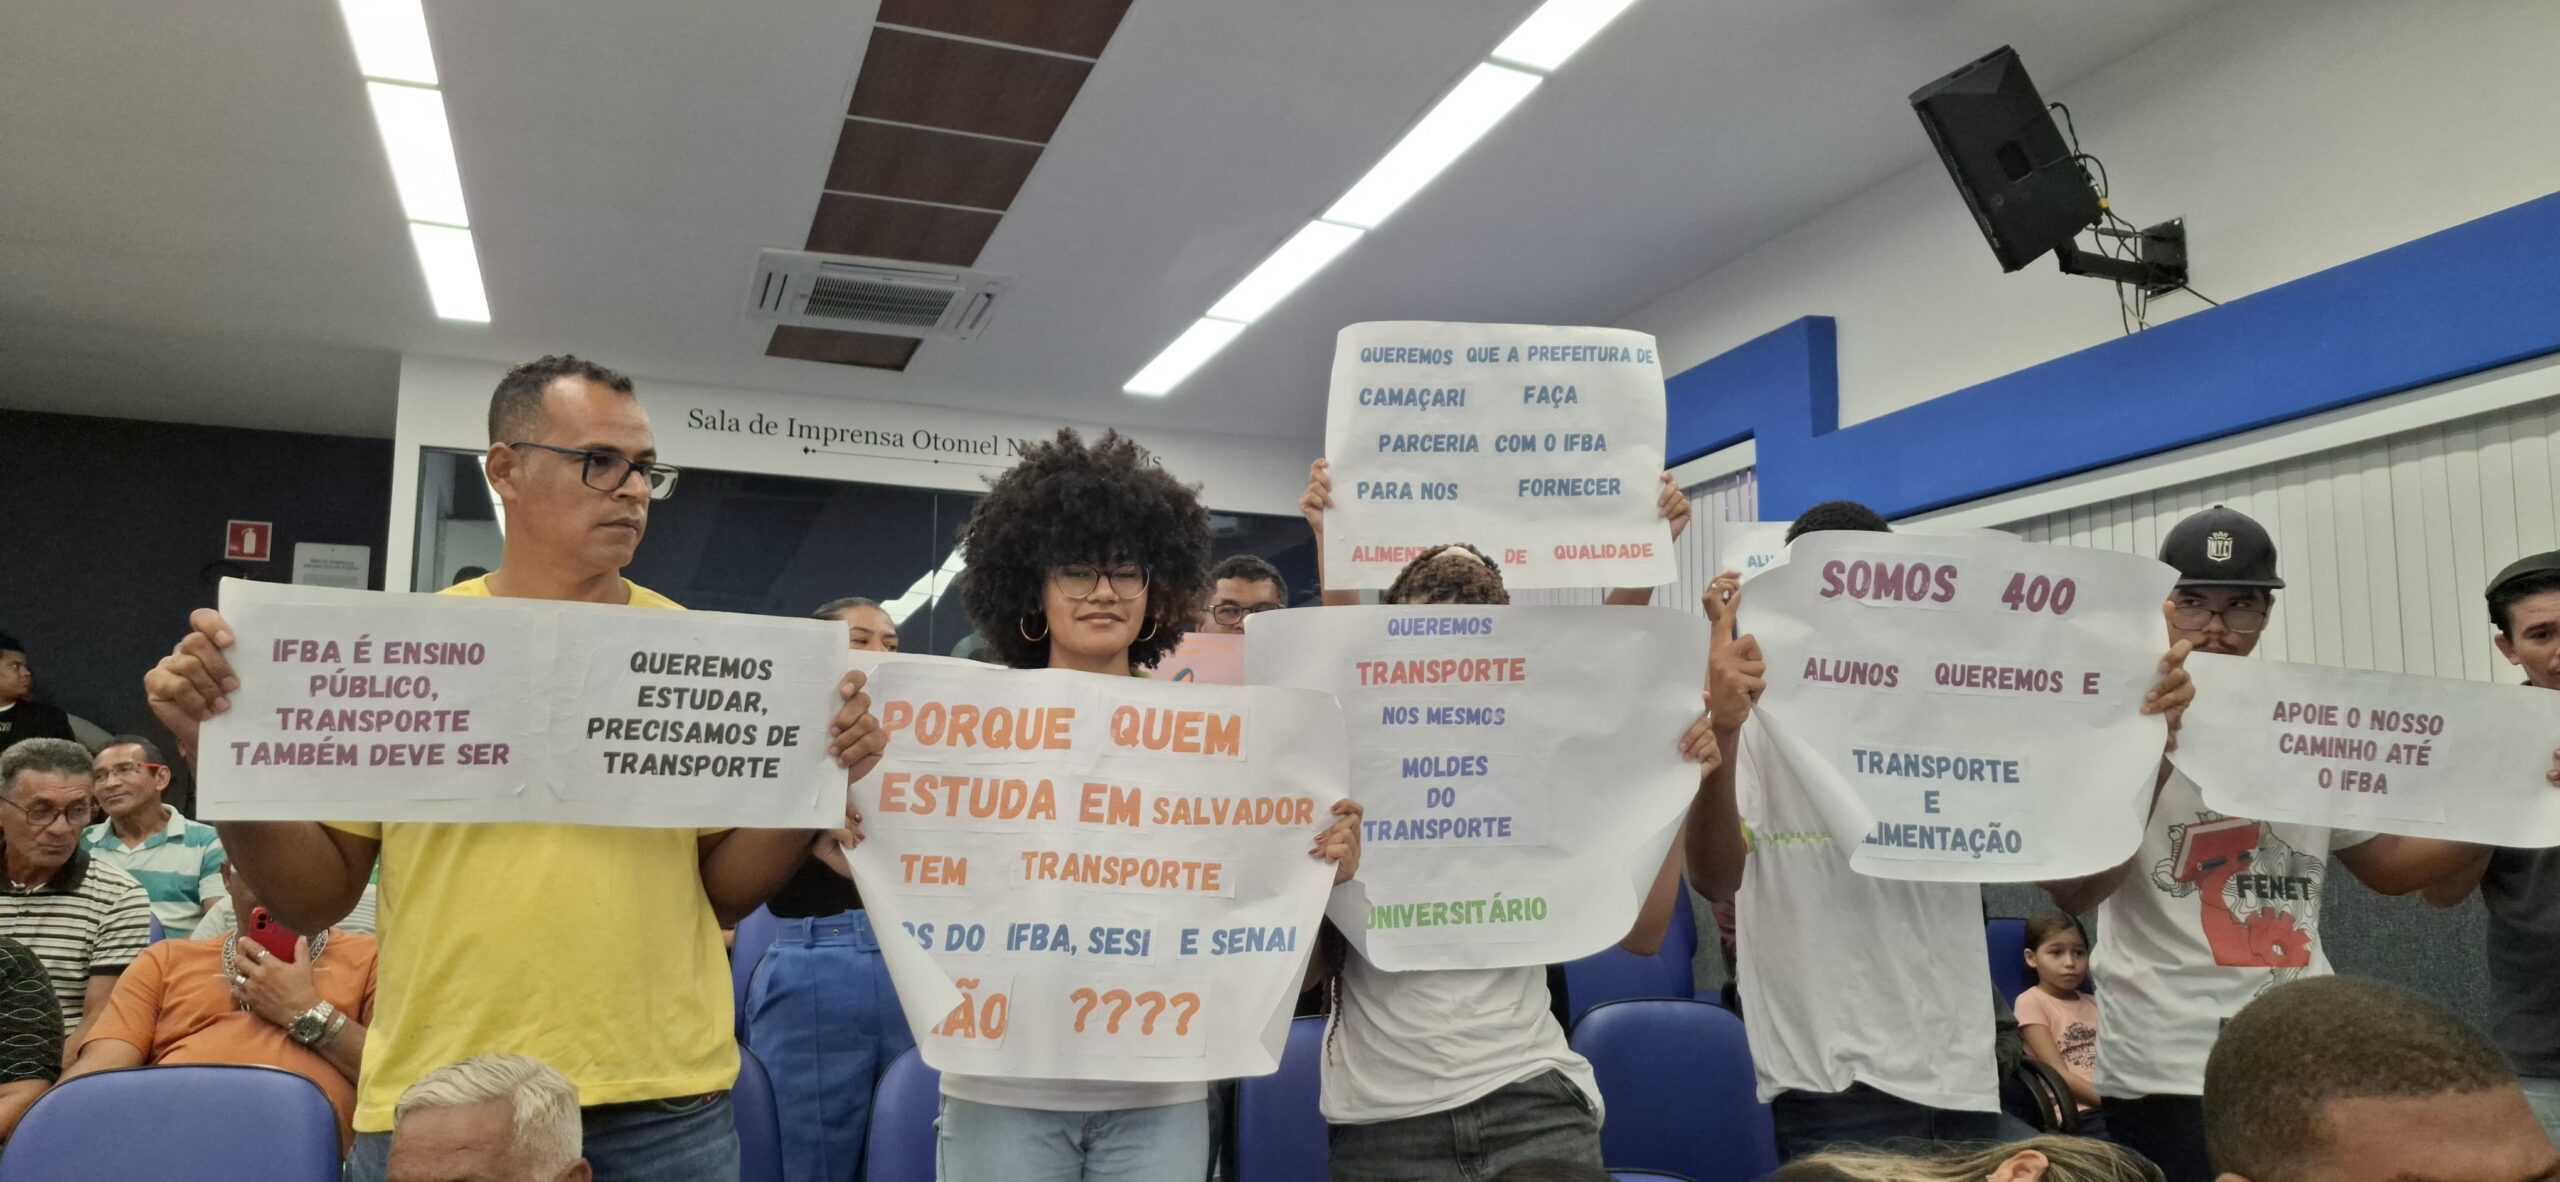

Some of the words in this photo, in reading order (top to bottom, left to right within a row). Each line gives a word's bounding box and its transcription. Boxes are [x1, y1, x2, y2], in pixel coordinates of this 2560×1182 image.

[1360, 347, 1454, 365] QUEREMOS
[1466, 347, 1500, 364] QUE
[1507, 347, 1520, 363] A
[1528, 346, 1631, 362] PREFEITURA
[1636, 348, 1655, 364] DE
[1359, 387, 1465, 411] CAMAÇARI
[1523, 385, 1578, 408] FAÇA
[688, 408, 741, 433] Sala
[749, 413, 778, 436] de
[788, 418, 904, 449] Imprensa
[1378, 434, 1479, 453] PARCERIA
[1495, 434, 1536, 453] COM
[1544, 434, 1556, 452] O
[1564, 433, 1607, 452] IFBA
[1357, 481, 1413, 500] PARA
[1420, 482, 1458, 500] NOS
[1518, 478, 1621, 497] FORNECER
[1505, 549, 1527, 564] DE
[1554, 544, 1654, 560] QUALIDADE
[1820, 560, 1958, 601] SOMOS
[2001, 573, 2076, 615] 400
[1388, 617, 1492, 636] QUEREMOS
[272, 640, 340, 664] IFBA
[353, 634, 372, 664] É
[384, 640, 485, 665] ENSINO
[630, 651, 773, 681] QUEREMOS
[1356, 658, 1526, 685] TRANSPORTE
[1803, 657, 1898, 688] ALUNOS
[1935, 663, 2063, 693] QUEREMOS
[2082, 672, 2100, 694] E
[309, 668, 438, 701] PÚBLICO,
[637, 686, 768, 716] ESTUDAR,
[1382, 707, 1419, 725] NOS
[1426, 707, 1505, 725] MESMOS
[276, 708, 470, 733] TRANSPORTE
[586, 717, 757, 747] PRECISAMOS
[766, 725, 800, 747] DE
[882, 700, 1076, 751] PORQUE
[1110, 705, 1241, 757] QUEM
[2272, 701, 2339, 727] APOIE
[2347, 708, 2360, 729] O
[2370, 710, 2444, 736] NOSSO
[231, 735, 357, 766] TAMBÉM
[370, 744, 445, 766] DEVE
[457, 742, 510, 765] SER
[2280, 733, 2377, 761] CAMINHO
[2386, 740, 2432, 766] ATÉ
[603, 751, 780, 779] TRANSPORTE
[1402, 755, 1488, 778] MOLDES
[1853, 749, 2020, 783] TRANSPORTE
[2318, 768, 2332, 789] O
[2341, 770, 2388, 794] IFBA
[879, 773, 1056, 821] ESTUDA
[1079, 783, 1142, 827] EM
[1152, 797, 1314, 827] SALVADOR
[1426, 787, 1456, 808] DO
[1924, 791, 1940, 814] E
[1364, 817, 1512, 841] TRANSPORTE
[901, 854, 967, 886] TEM
[1021, 851, 1222, 891] TRANSPORTE
[2237, 875, 2312, 900] FENET
[944, 923, 985, 952] DO
[1006, 922, 1076, 956] IFBA,
[1088, 926, 1151, 957] SESI
[1180, 928, 1198, 956] E
[1210, 925, 1297, 956] SENAI
[930, 977, 1008, 1039] ÃO
[1070, 987, 1200, 1037] ????
